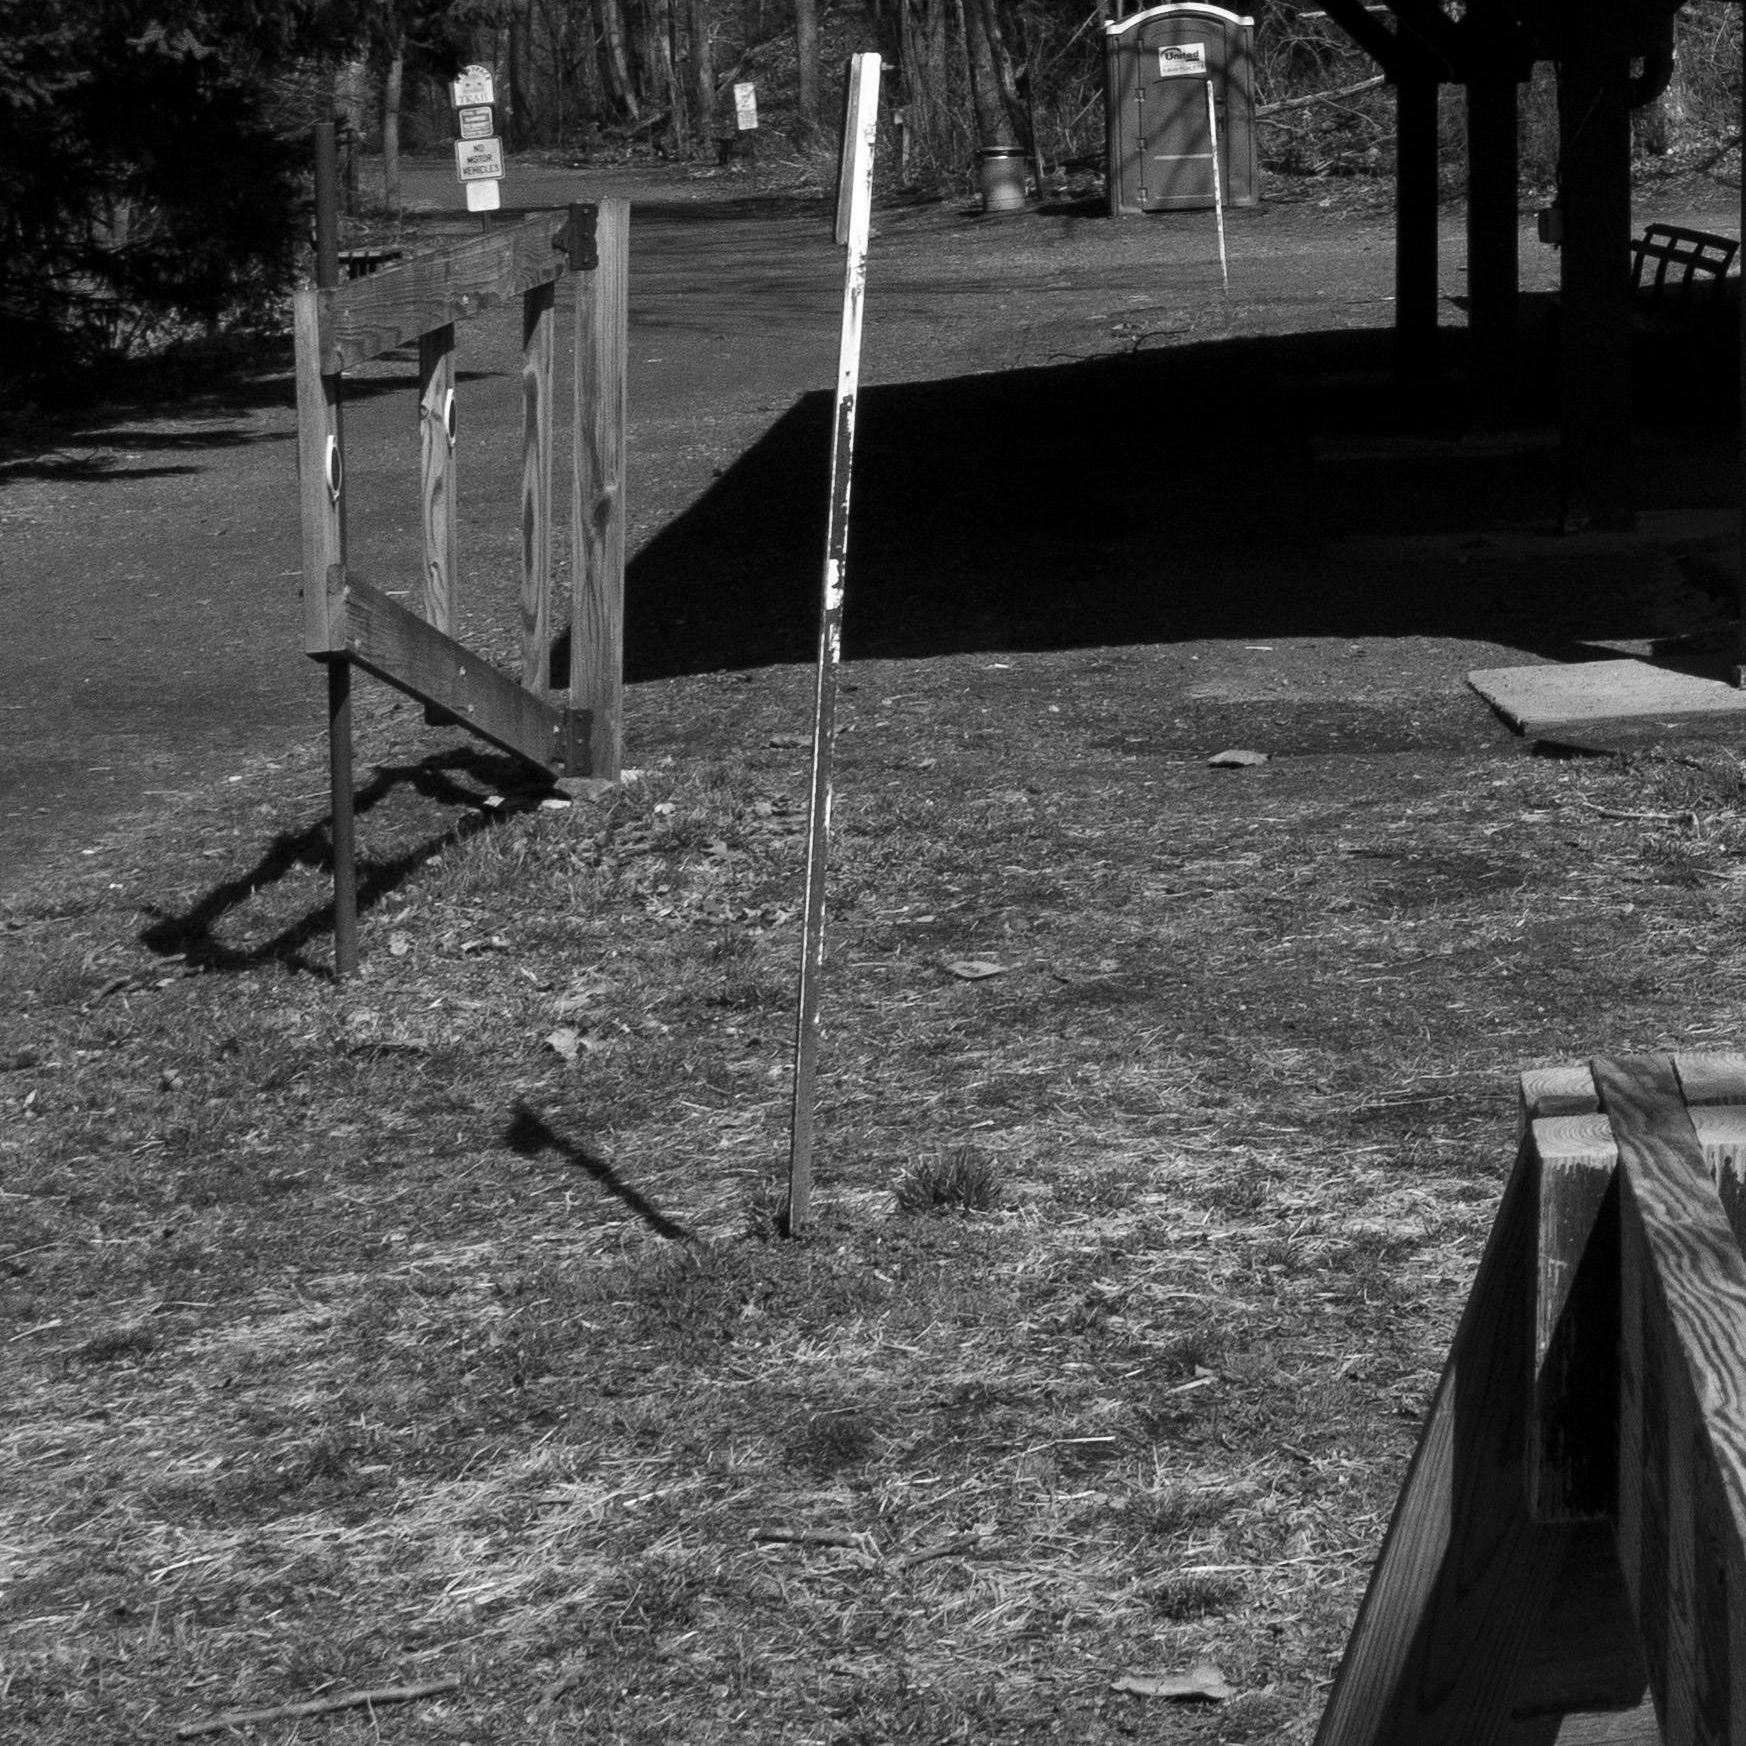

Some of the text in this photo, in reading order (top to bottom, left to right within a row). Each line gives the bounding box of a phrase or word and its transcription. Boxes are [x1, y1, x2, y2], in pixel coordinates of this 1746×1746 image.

[1164, 50, 1199, 61] United
[457, 92, 489, 104] TRAIL
[473, 143, 485, 153] NO
[466, 154, 492, 164] MOTOR
[462, 164, 500, 176] VEHICLES
